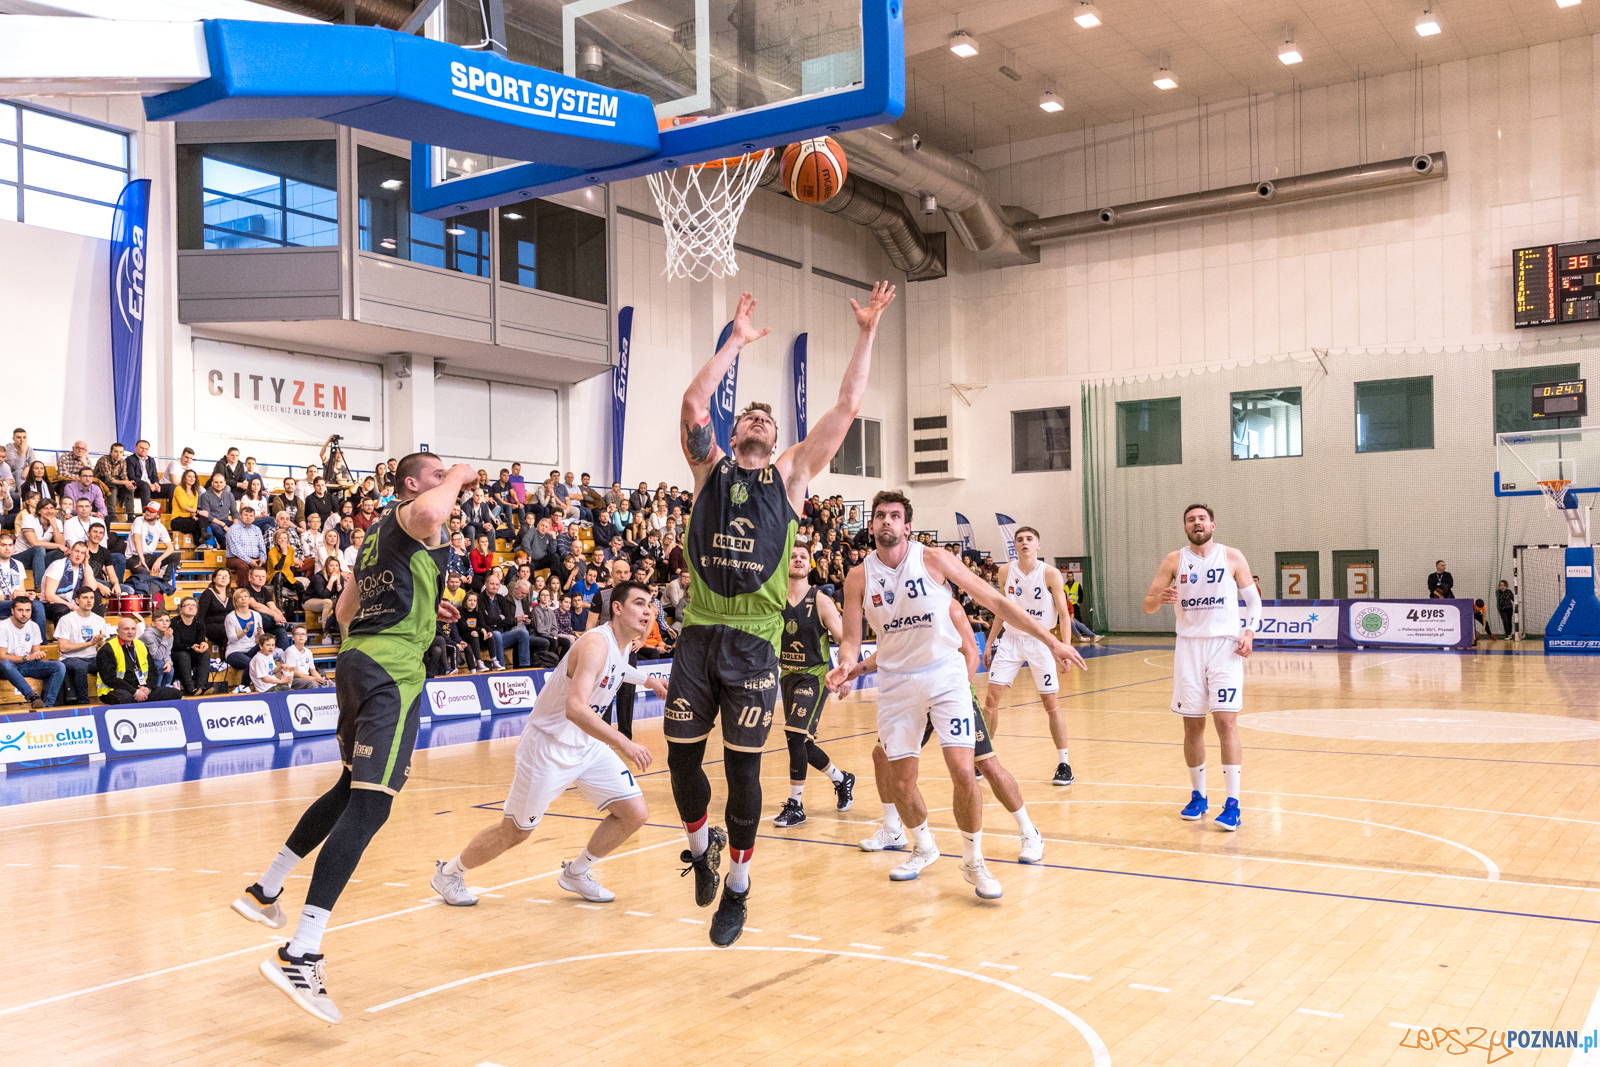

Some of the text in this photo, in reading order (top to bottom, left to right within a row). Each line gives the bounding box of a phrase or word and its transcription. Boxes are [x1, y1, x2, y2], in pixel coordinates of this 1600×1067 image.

[451, 61, 619, 119] SPORT SYSTEM
[1568, 255, 1588, 270] 35
[128, 225, 144, 322] Enea
[618, 337, 629, 404] Enea
[208, 369, 347, 411] CITYZEN
[721, 360, 738, 413] Ene
[294, 408, 311, 416] KLUB
[314, 411, 347, 420] SPORTOWY
[716, 536, 751, 550] ORLEN
[713, 557, 764, 572] TRANSITION
[1207, 568, 1225, 583] 97
[1354, 572, 1367, 594] 3
[905, 577, 927, 599] 31
[1289, 573, 1300, 594] 2
[1034, 587, 1042, 599] 2
[1181, 597, 1224, 607] BIOFARM
[806, 604, 813, 617] 7
[1407, 609, 1445, 622] 4 eyes
[1044, 674, 1052, 686] 2
[1218, 688, 1237, 703] 97
[666, 709, 691, 719] ORLEN
[738, 706, 762, 728] 10
[138, 719, 179, 732] DIAGNOSTYKA
[207, 714, 265, 730] BIOFARM
[950, 718, 970, 736] 31
[25, 727, 94, 745] funclub
[28, 742, 53, 750] biuro
[621, 769, 634, 786] 7
